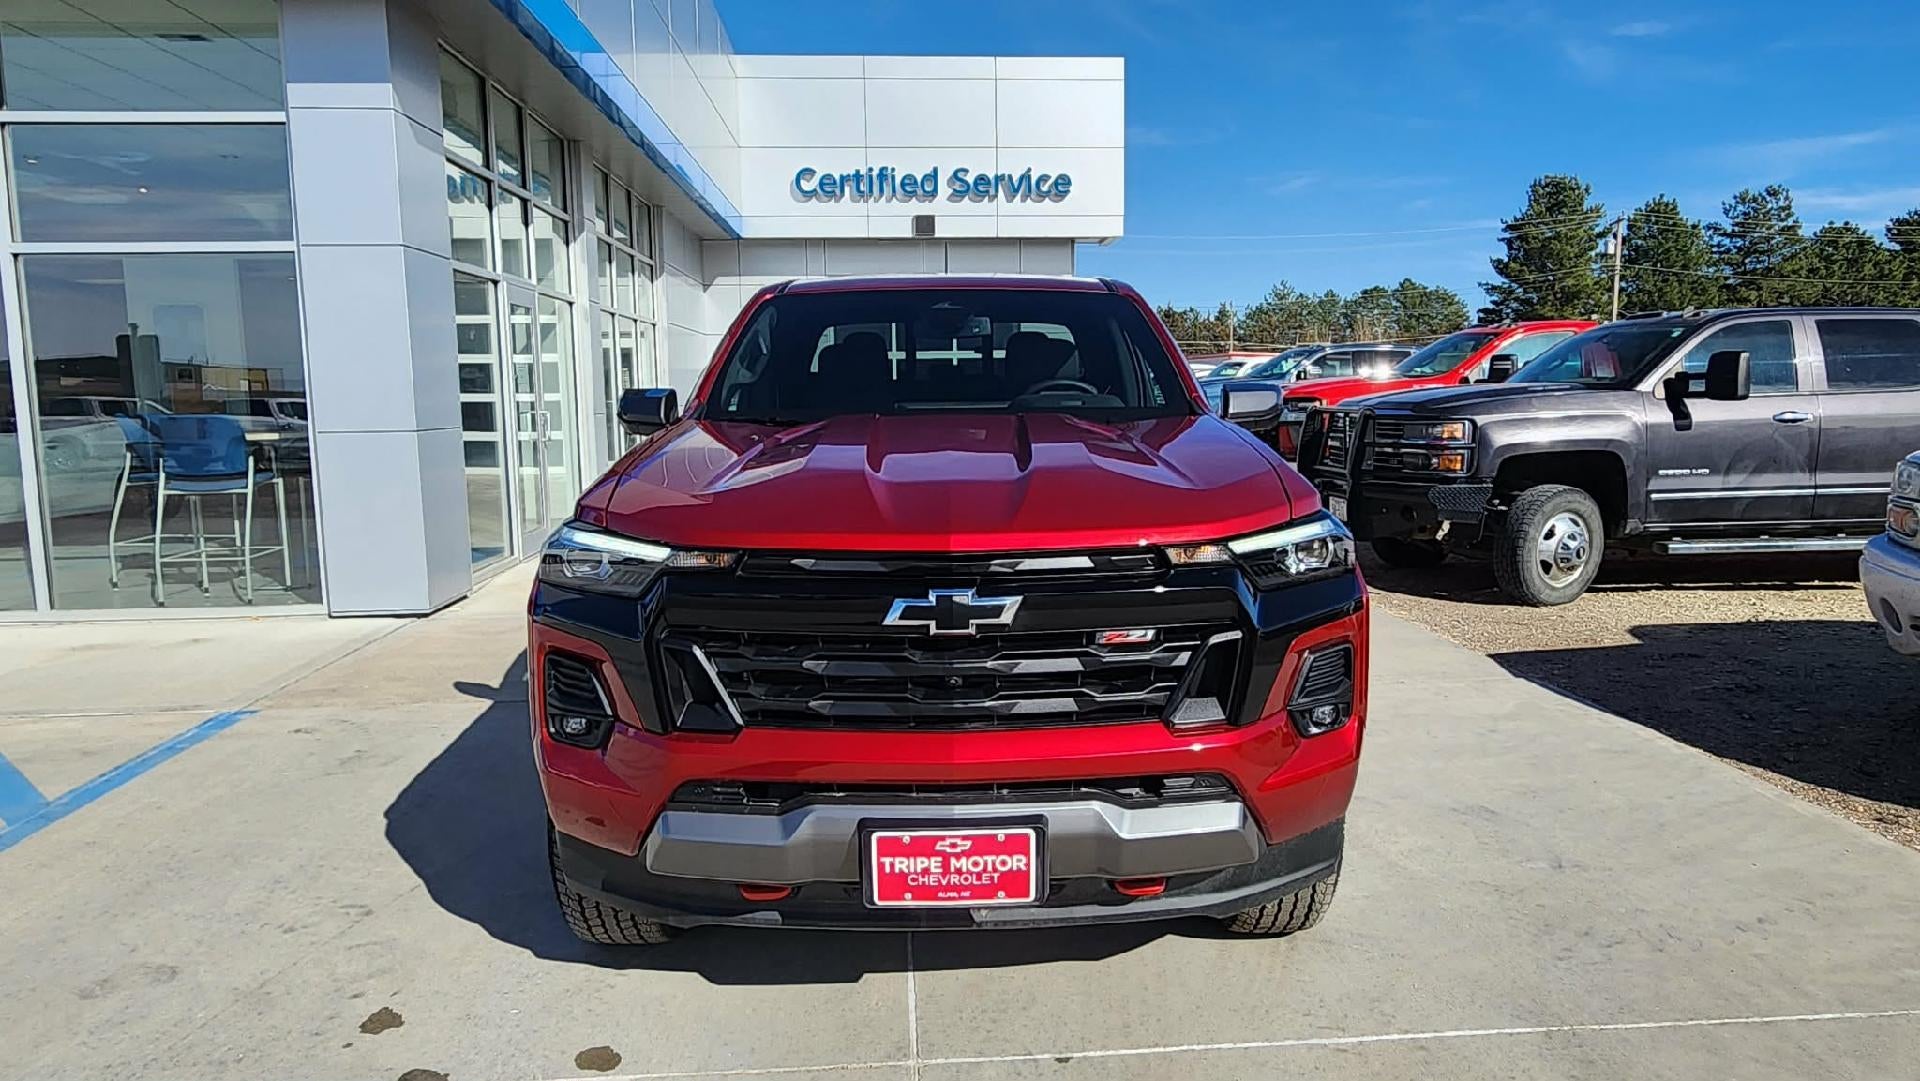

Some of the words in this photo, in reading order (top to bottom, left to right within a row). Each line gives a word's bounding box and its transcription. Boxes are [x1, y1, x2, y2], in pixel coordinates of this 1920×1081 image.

[794, 166, 938, 196] Certified
[952, 167, 1072, 196] Service
[880, 856, 942, 874] TRIPE
[950, 854, 1027, 873] MOTOR
[907, 873, 1000, 886] CHEVROLET
